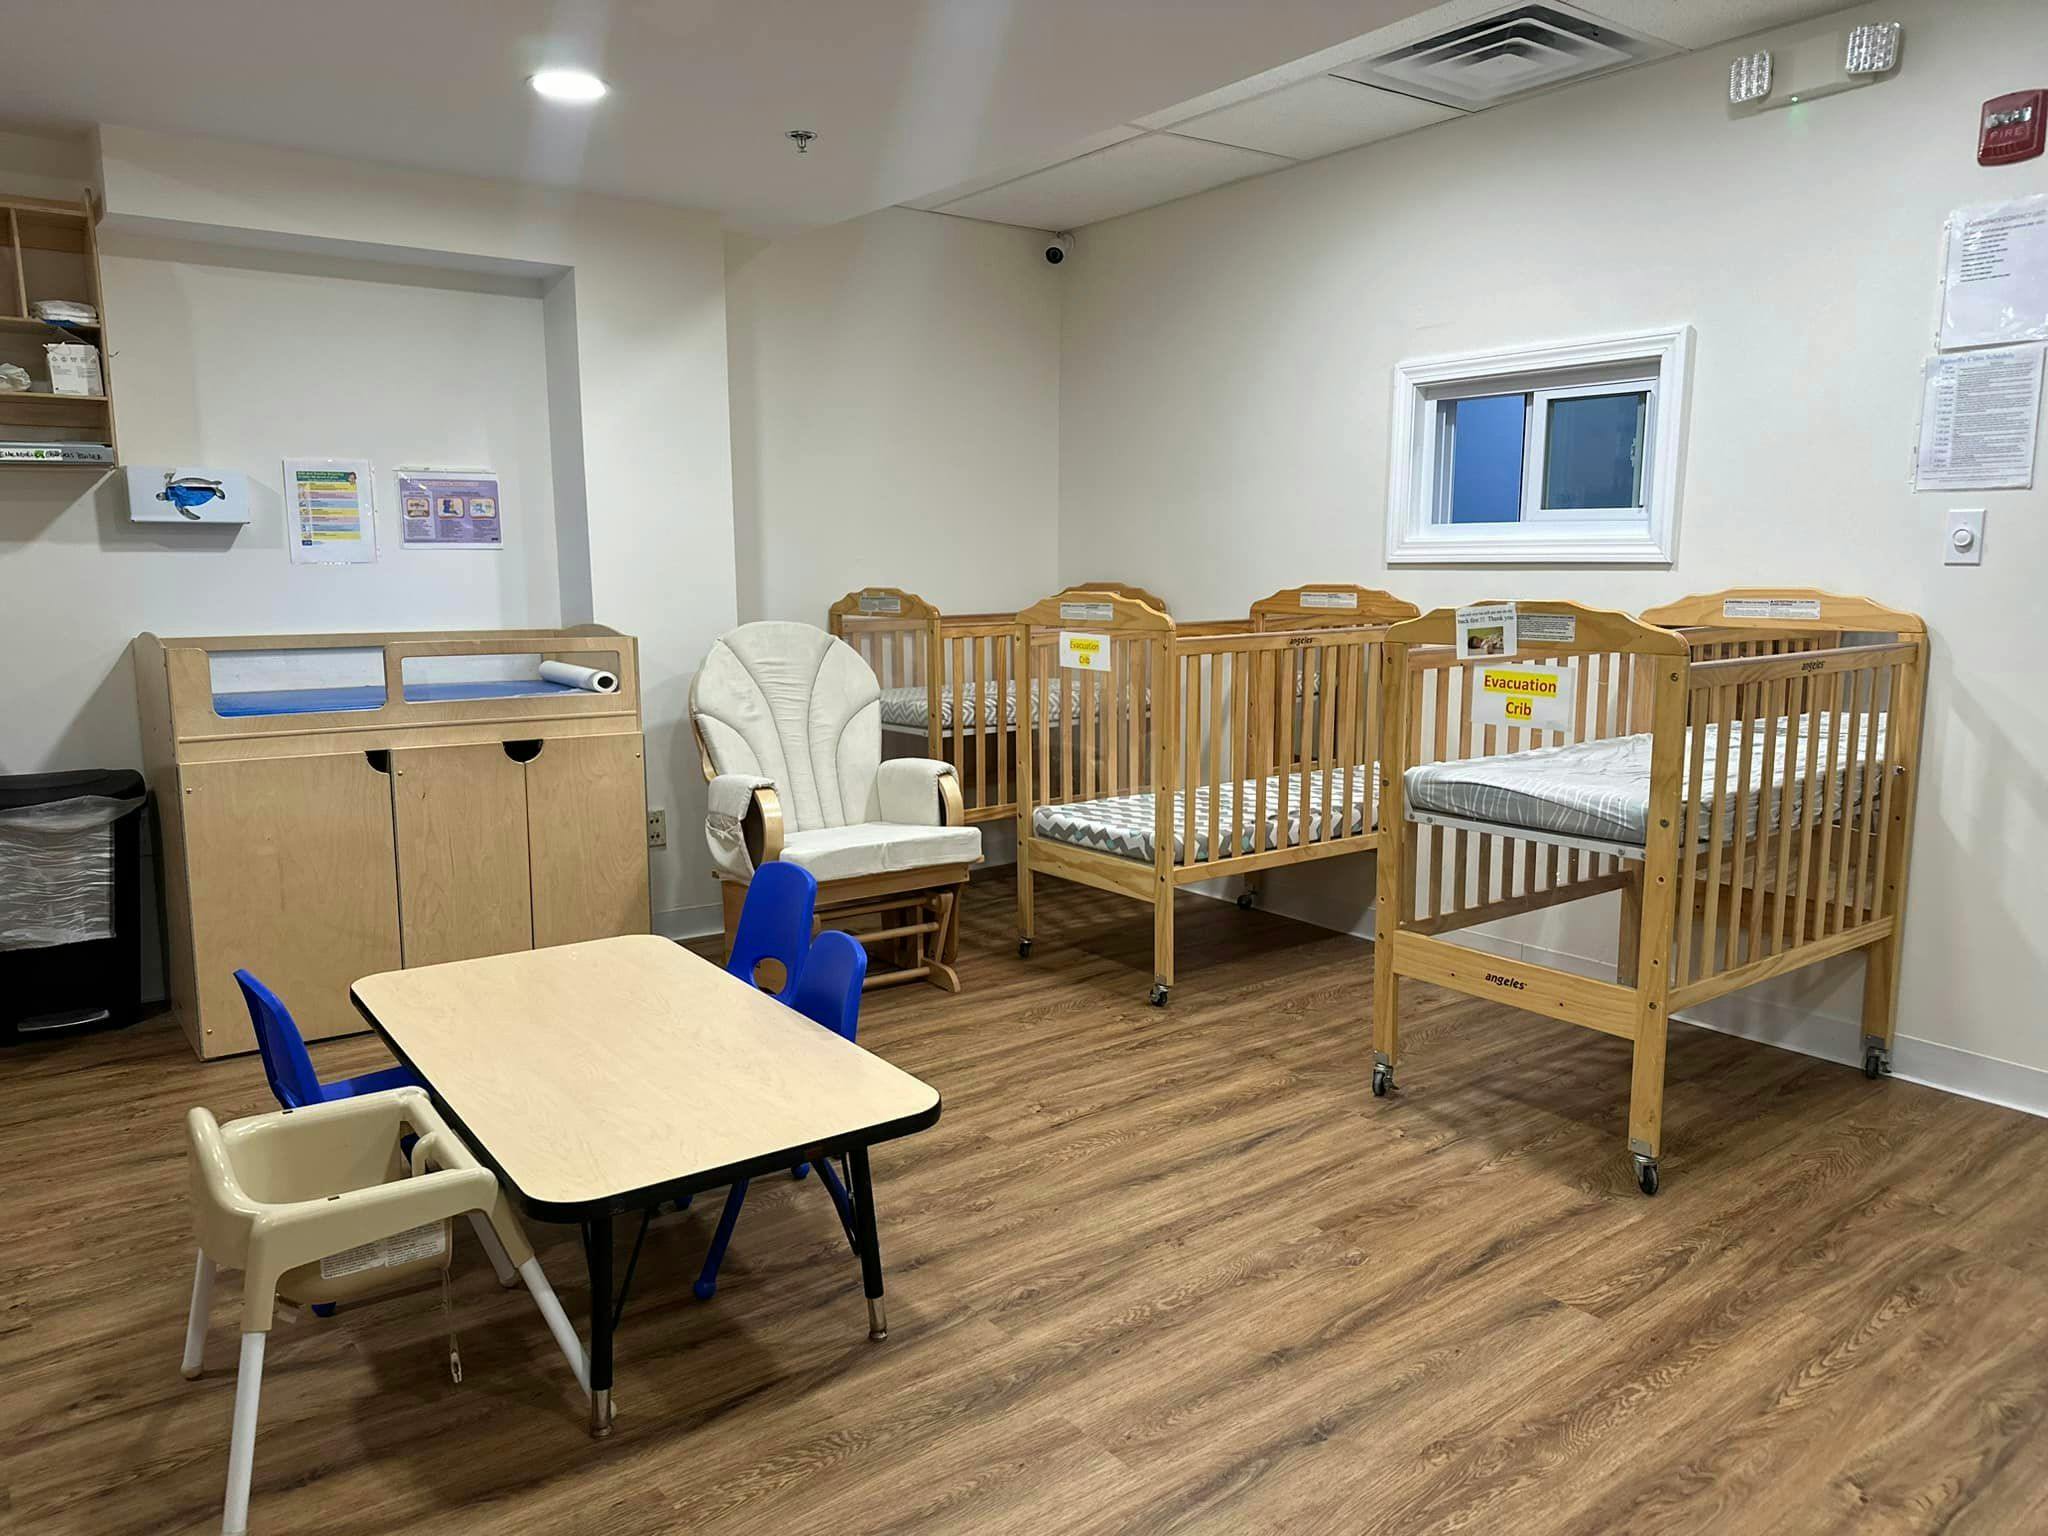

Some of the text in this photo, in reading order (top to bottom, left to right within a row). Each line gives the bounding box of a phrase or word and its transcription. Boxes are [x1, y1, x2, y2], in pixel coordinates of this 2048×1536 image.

[1990, 127, 2023, 138] FIRE
[1070, 639, 1099, 650] Evacuation
[1484, 675, 1557, 693] Evacuation
[1506, 702, 1532, 716] Crib
[1485, 973, 1525, 990] angeles
